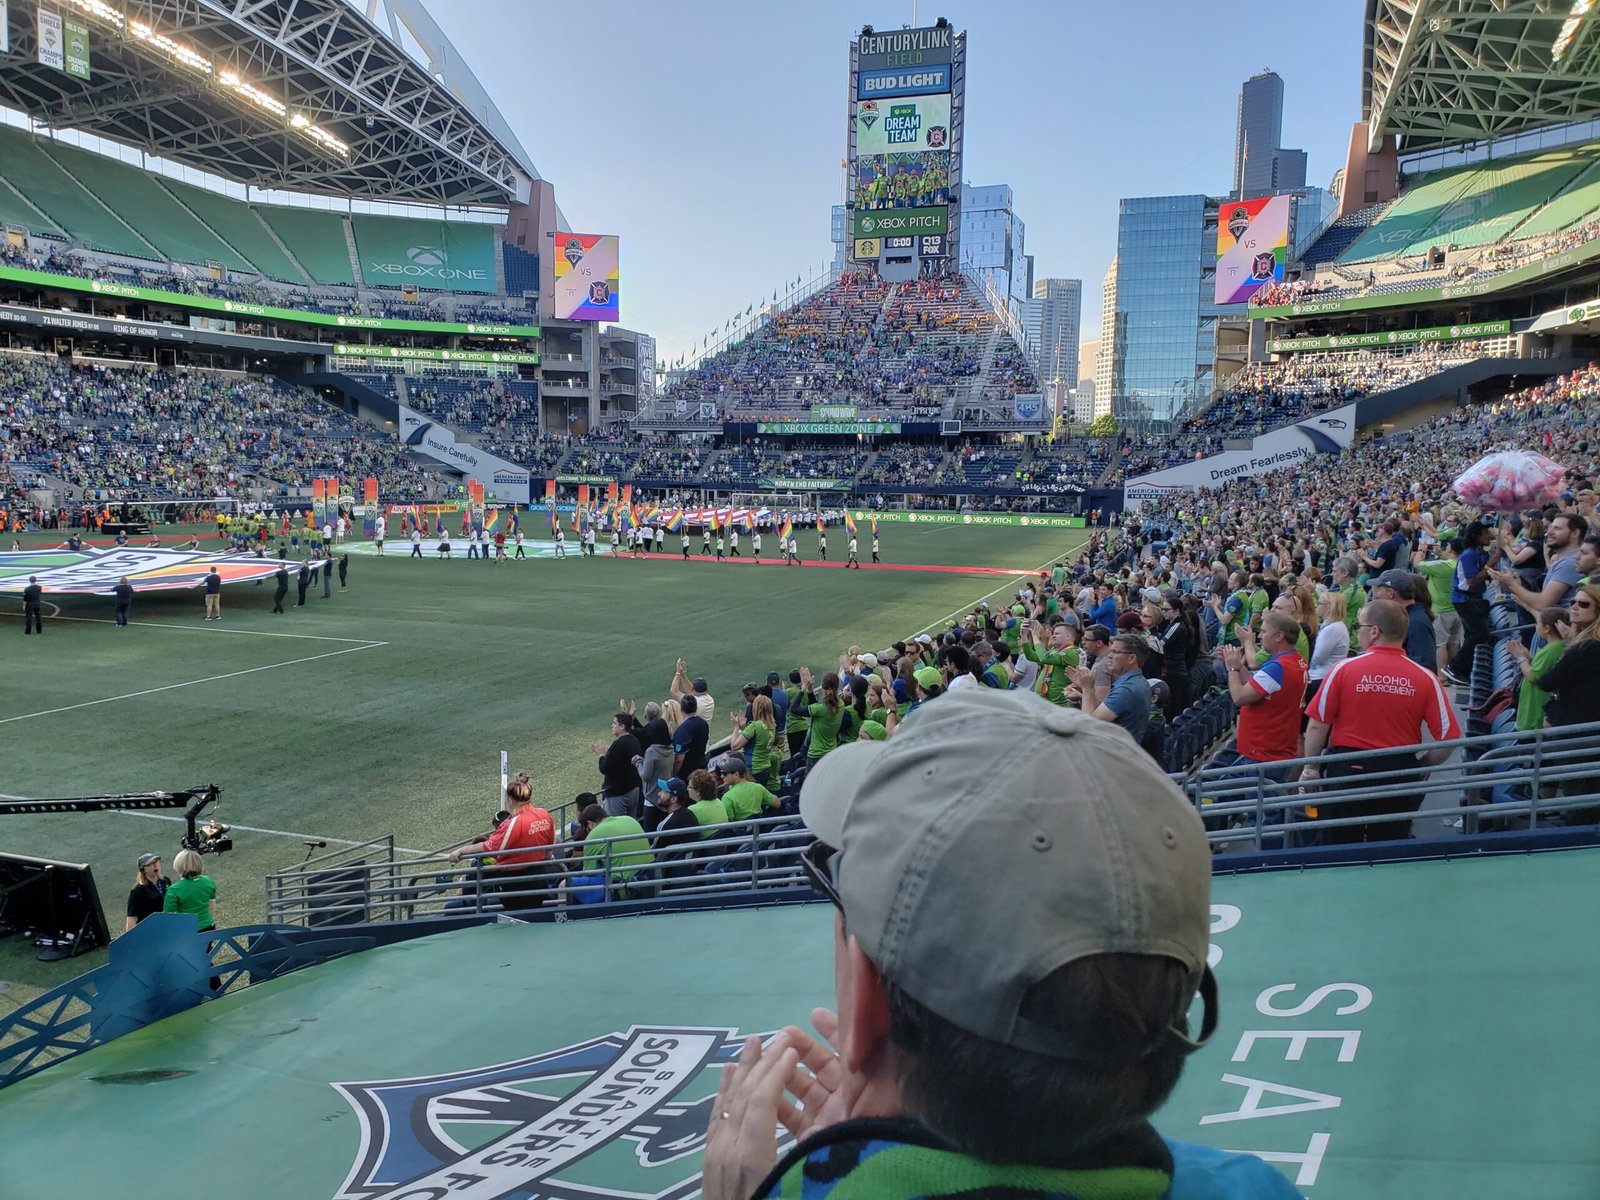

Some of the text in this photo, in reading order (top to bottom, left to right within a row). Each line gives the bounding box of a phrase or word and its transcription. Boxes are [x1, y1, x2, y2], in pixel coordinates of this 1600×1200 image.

[40, 17, 61, 30] SHIELD
[40, 48, 63, 60] CHAMPS
[887, 52, 923, 66] FIELD
[865, 72, 943, 91] BUD LIGHT
[886, 116, 919, 130] DREAM
[890, 128, 916, 142] TEAM
[876, 216, 940, 229] XBOX PITCH
[893, 238, 911, 247] 0:00
[922, 236, 940, 246] Q13
[1244, 240, 1256, 248] VS
[923, 246, 940, 254] FOX
[372, 262, 488, 280] XBOX ONE
[102, 284, 139, 296] XBOX PITCH
[1452, 283, 1490, 296] XBOX PITCH
[232, 304, 264, 314] XBOX PITCH
[1302, 302, 1340, 312] XBOX PITCH
[50, 317, 72, 326] WALTER
[72, 320, 88, 328] JONES
[364, 319, 382, 327] PITCH
[114, 324, 129, 334] RING
[138, 327, 158, 336] HONOR
[476, 325, 510, 334] XBOX PITCH
[1460, 324, 1505, 336] XBOX PITCH
[1338, 335, 1380, 346] XBOX PITCH
[1398, 330, 1440, 342] XBOX PITCH
[345, 346, 383, 355] XBOX PITCH
[1282, 339, 1321, 350] XBOX PITCH
[450, 352, 484, 360] XBOX PITCH
[500, 354, 534, 362] XBOX PITCH
[784, 425, 872, 433] XBOX GREEN ZONE
[427, 437, 478, 468] Insure Carefully
[1210, 463, 1248, 480] Dream
[1360, 674, 1414, 688] ALCOHOL
[1356, 684, 1416, 697] ENFORCEMENT
[486, 1037, 680, 1168] SOUNDERS
[524, 1070, 676, 1170] SEATTLE
